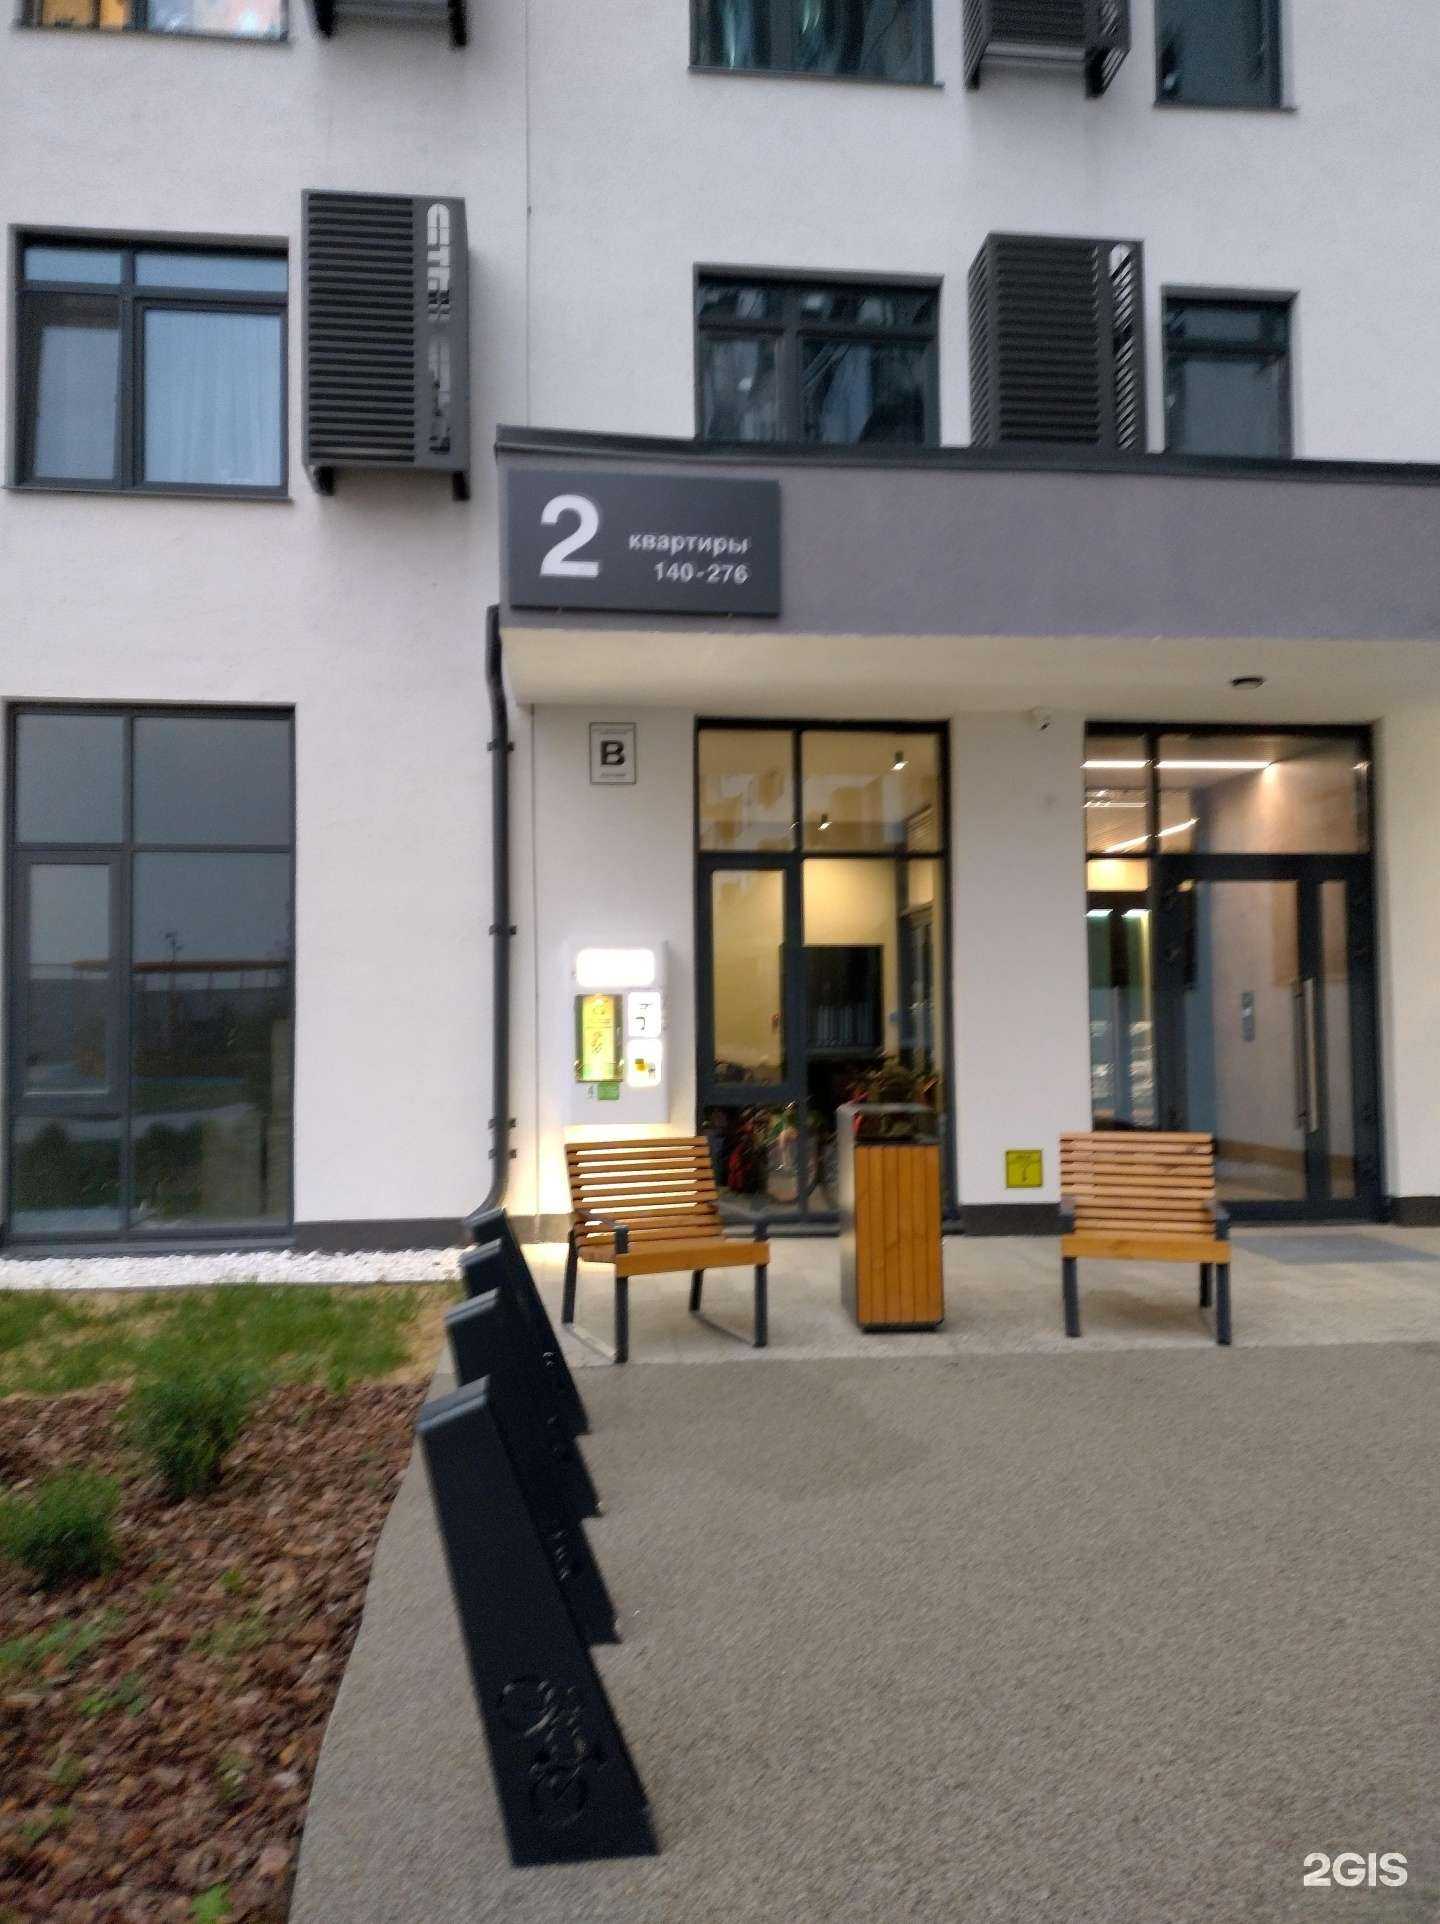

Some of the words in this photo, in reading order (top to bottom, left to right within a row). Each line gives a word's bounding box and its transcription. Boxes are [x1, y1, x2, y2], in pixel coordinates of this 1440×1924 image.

[540, 494, 600, 578] 2
[628, 534, 749, 557] квартиры
[654, 561, 749, 584] 140-276
